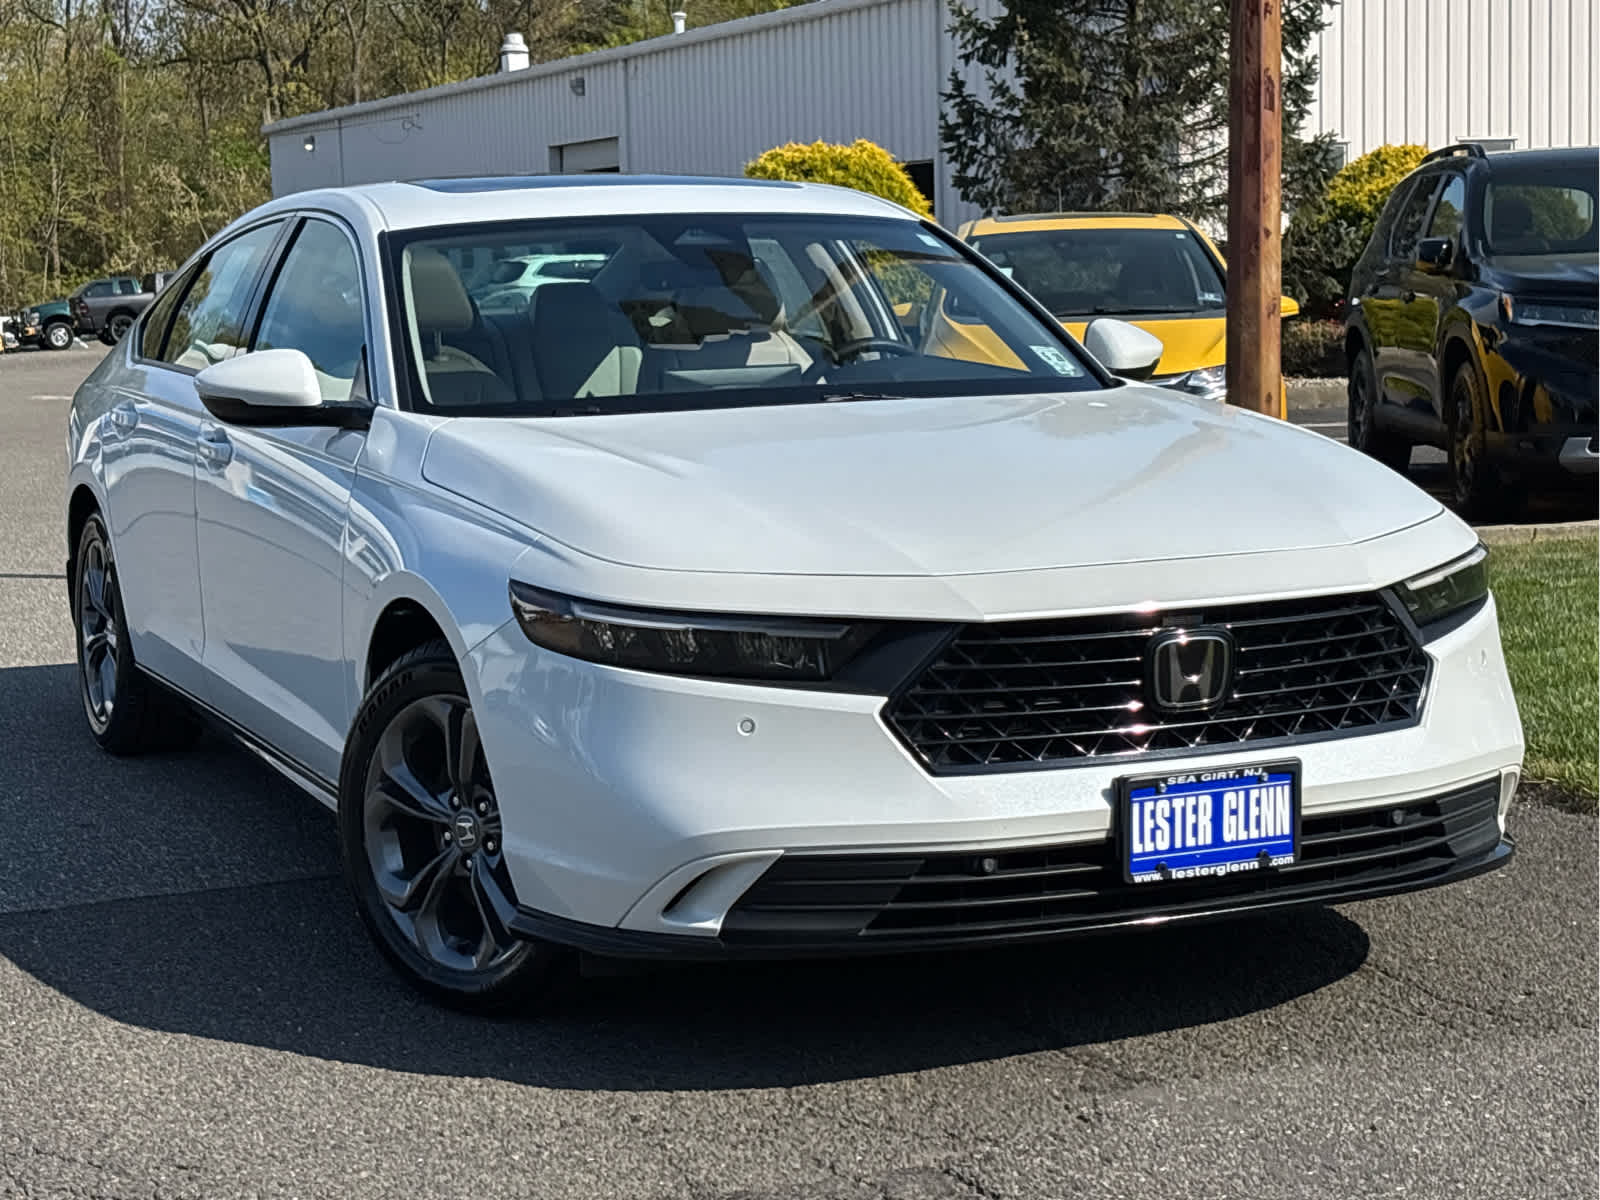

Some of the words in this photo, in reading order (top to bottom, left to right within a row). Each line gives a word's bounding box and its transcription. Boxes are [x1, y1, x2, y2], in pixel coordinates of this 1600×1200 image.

[1167, 776, 1197, 785] SEA
[1201, 771, 1240, 780] GIRT,
[1244, 768, 1263, 777] NJ
[1132, 795, 1213, 854] LESTER
[1223, 784, 1290, 843] GLENN
[1133, 872, 1163, 884] www.
